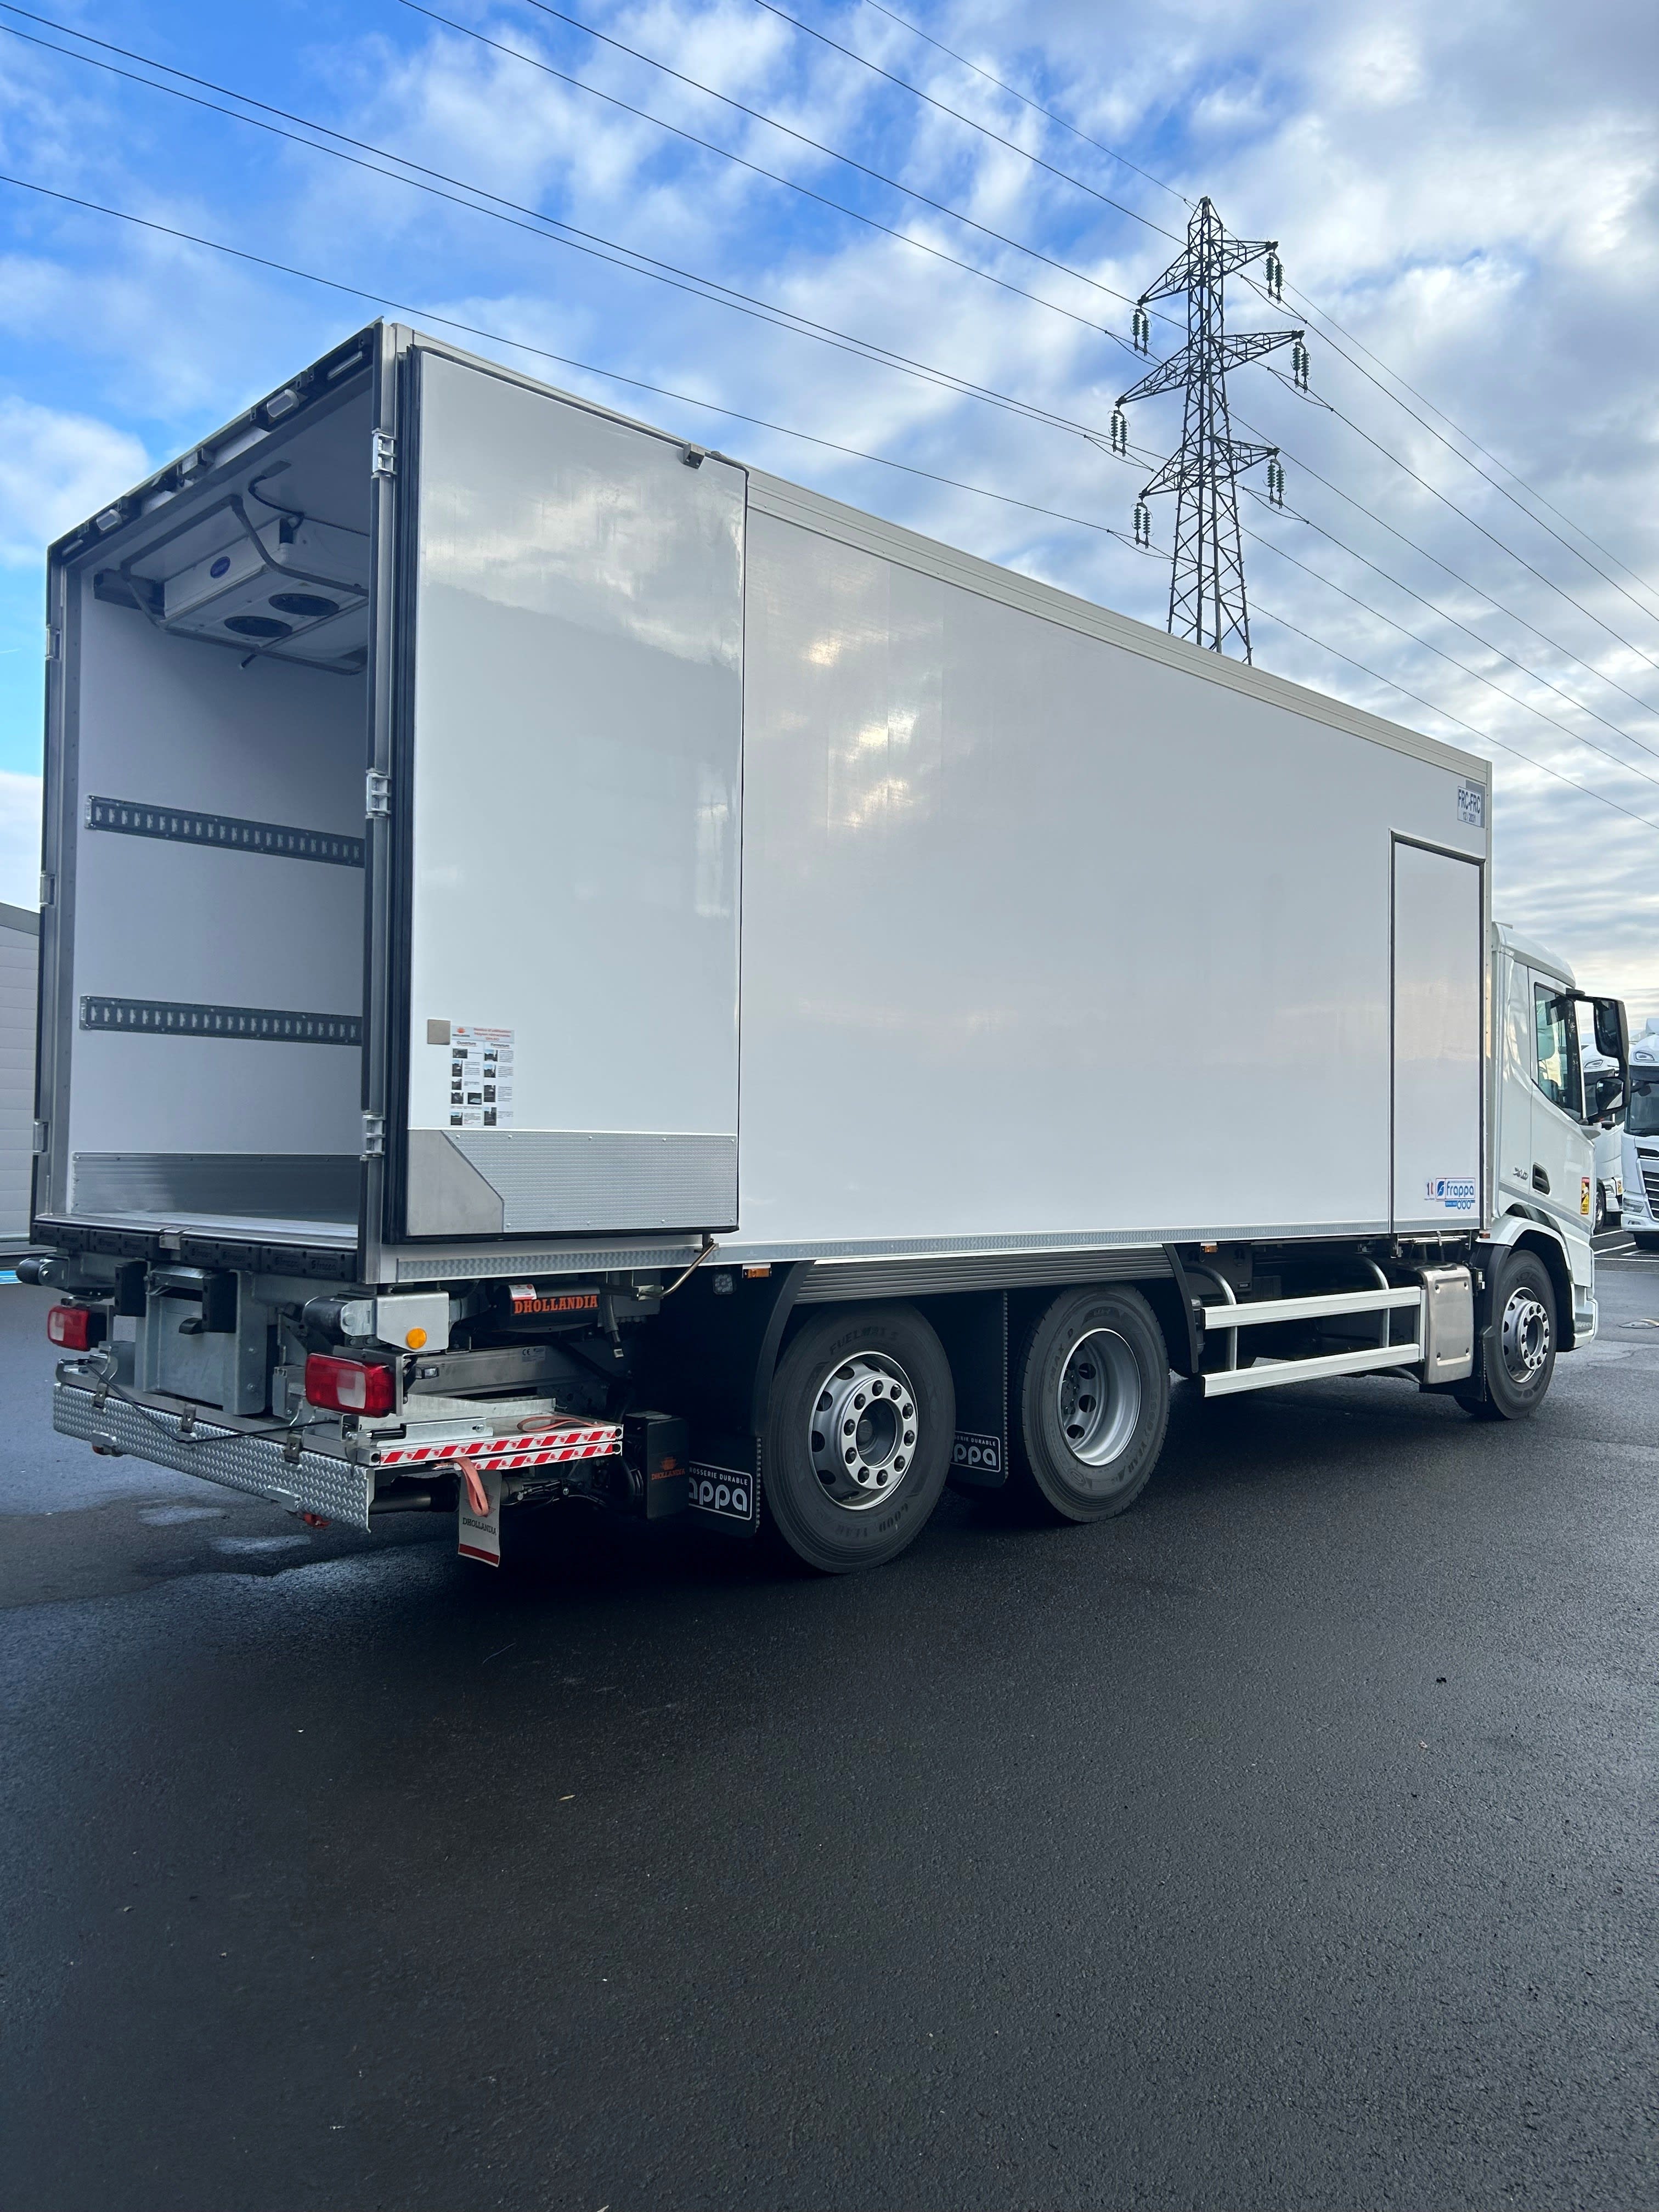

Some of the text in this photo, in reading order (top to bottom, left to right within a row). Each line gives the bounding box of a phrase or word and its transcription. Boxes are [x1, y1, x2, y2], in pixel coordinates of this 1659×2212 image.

[1458, 789, 1480, 814] FRC-FRC
[1447, 1181, 1474, 1197] frappa
[514, 1295, 598, 1314] DHOLLANDIA
[970, 1437, 996, 1447] DURABLE
[651, 1468, 685, 1480] DHOLLANDIA
[719, 1474, 748, 1486] DURABLE
[462, 1517, 497, 1536] DHOLLANDIA
